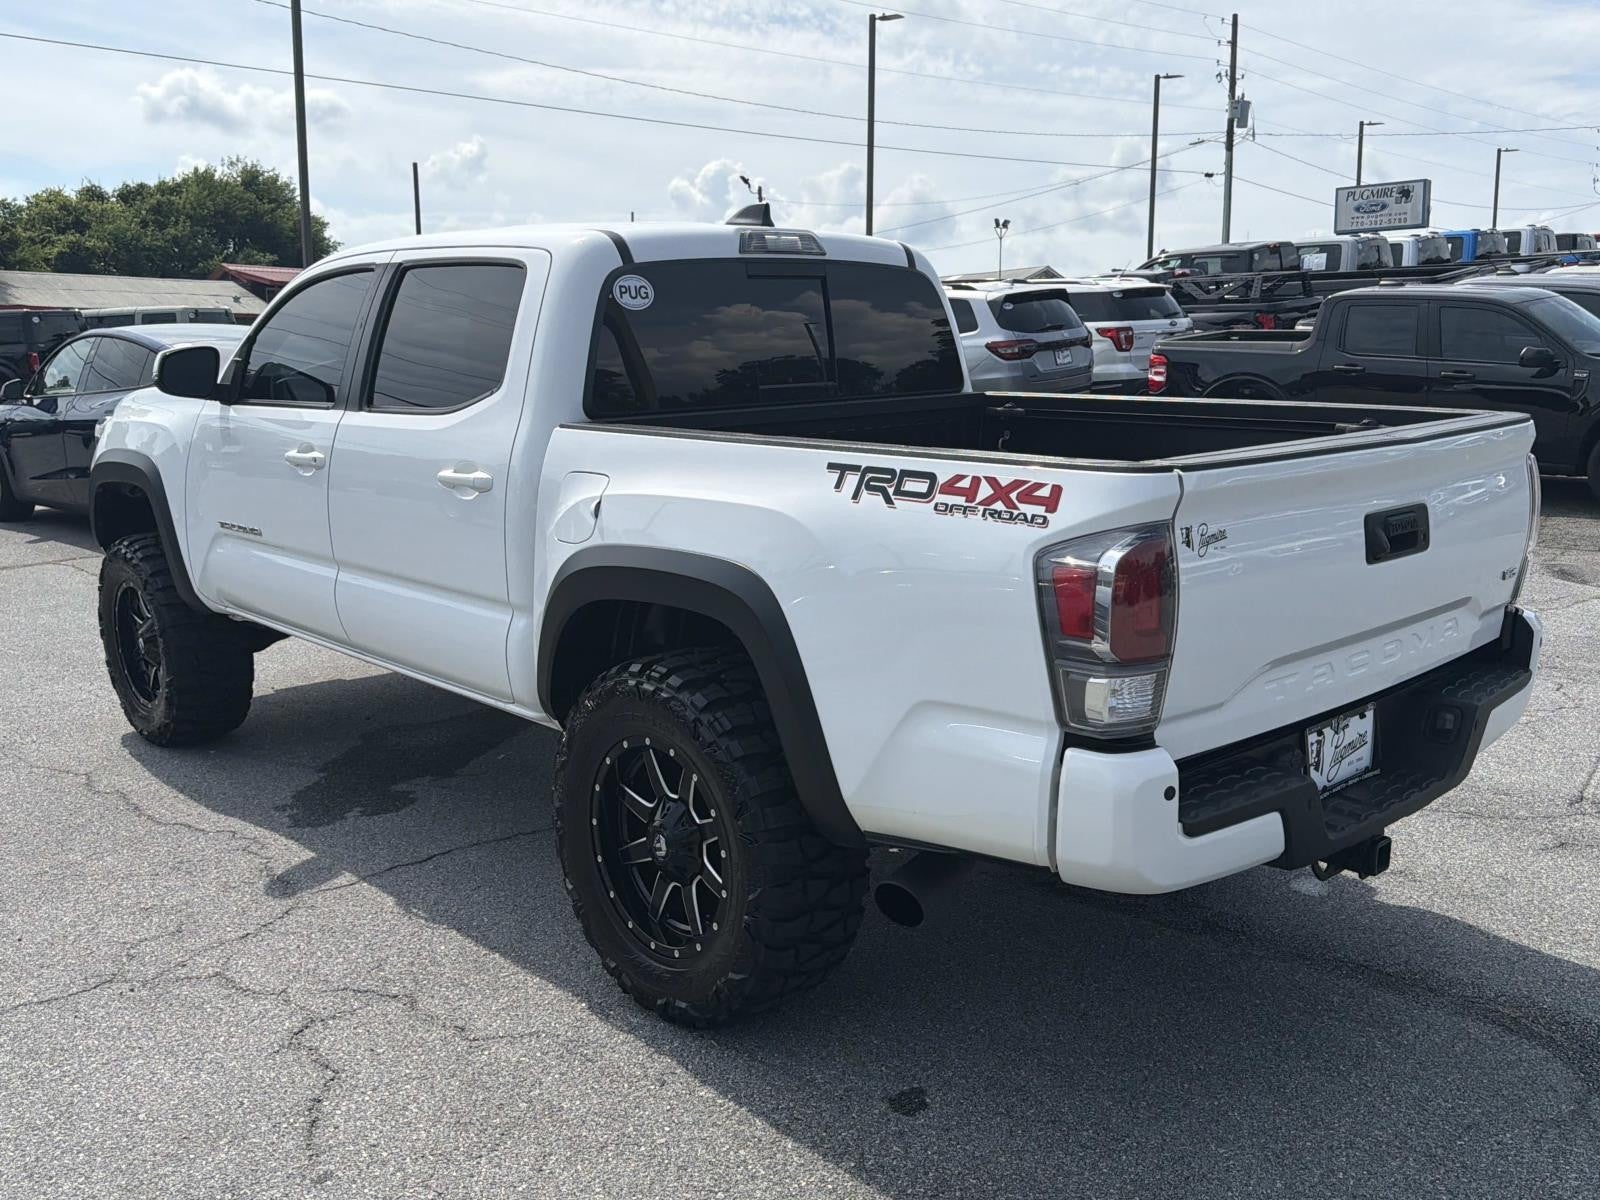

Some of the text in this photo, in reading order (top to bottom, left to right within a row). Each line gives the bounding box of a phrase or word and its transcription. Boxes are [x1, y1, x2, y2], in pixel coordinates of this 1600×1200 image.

[1345, 186, 1396, 202] PUGMIRE
[619, 285, 649, 299] PUG
[826, 462, 938, 509] TRD
[933, 502, 1049, 529] OFF ROAD
[1264, 616, 1459, 700] TACOMA
